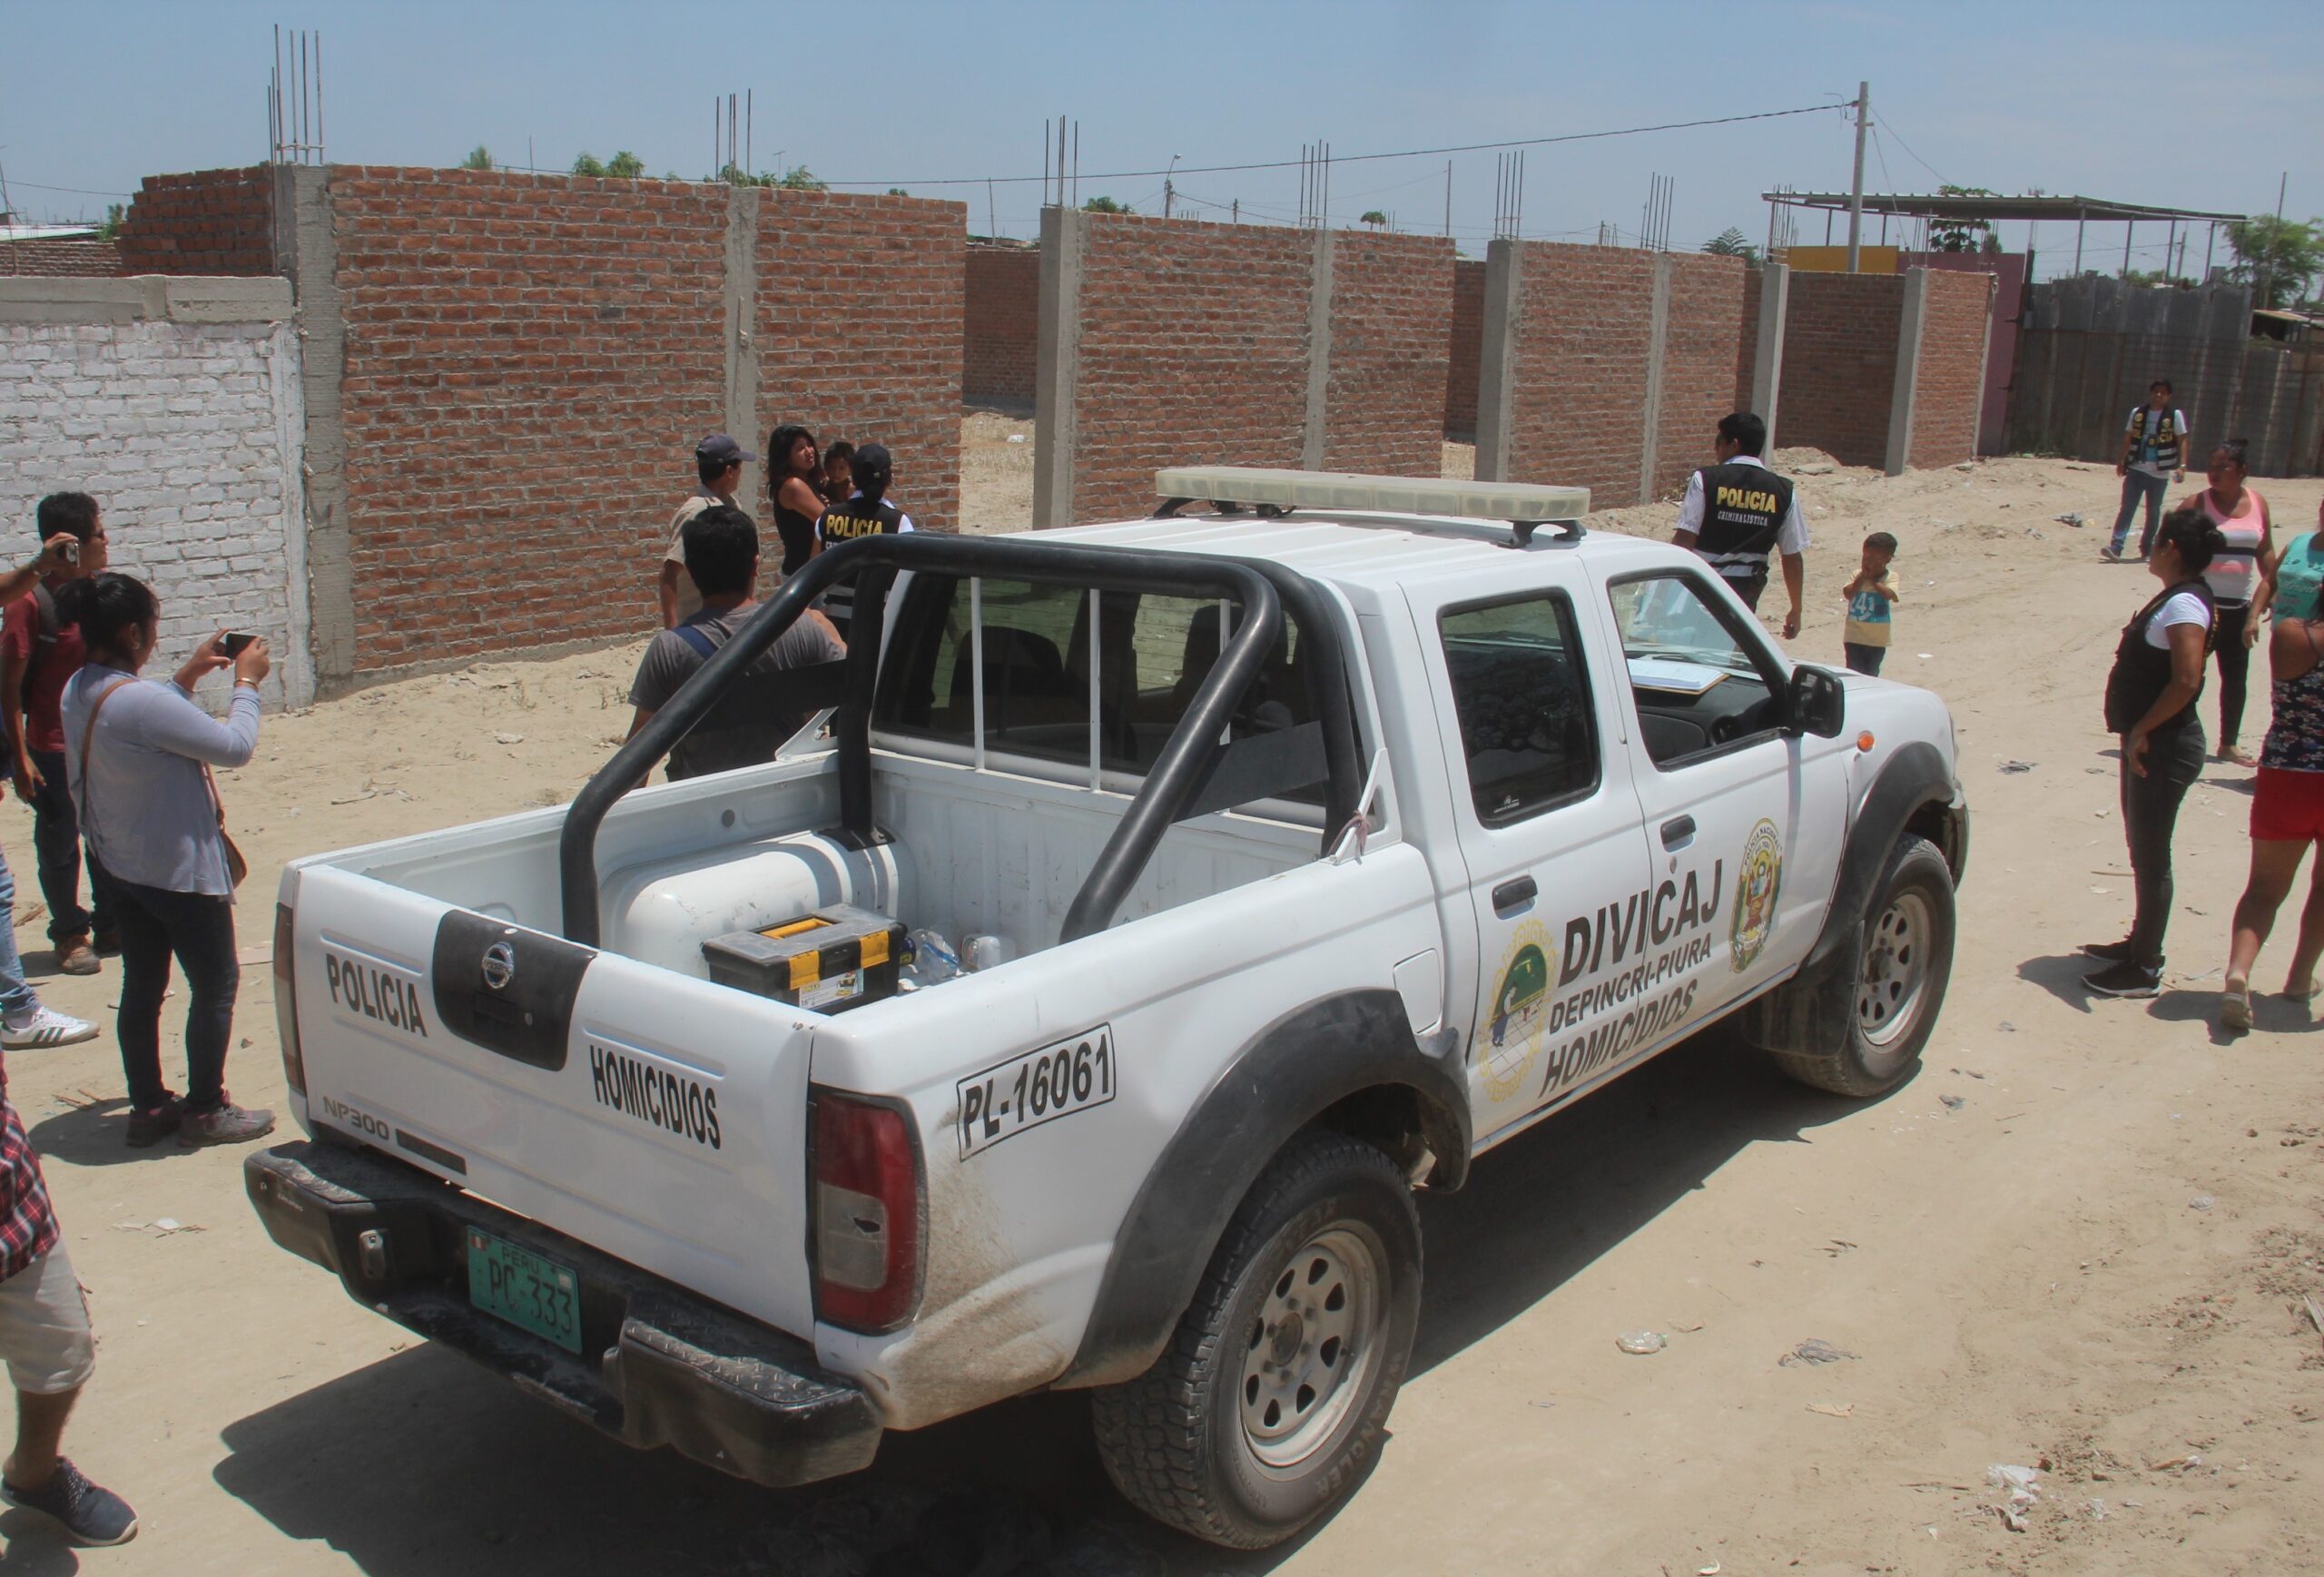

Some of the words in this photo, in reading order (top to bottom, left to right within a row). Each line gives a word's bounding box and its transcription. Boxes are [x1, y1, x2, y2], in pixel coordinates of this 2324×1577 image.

[1558, 859, 1723, 989] DIVICAJ
[325, 952, 428, 1039] POLICIA
[1549, 932, 1712, 1035] DEPINCRI-PIURA
[1538, 978, 1698, 1099] HOMICIDIOS
[322, 1096, 390, 1141] NP300
[590, 1045, 722, 1150] HOMICIDIOS
[963, 1033, 1110, 1150] PL-16061
